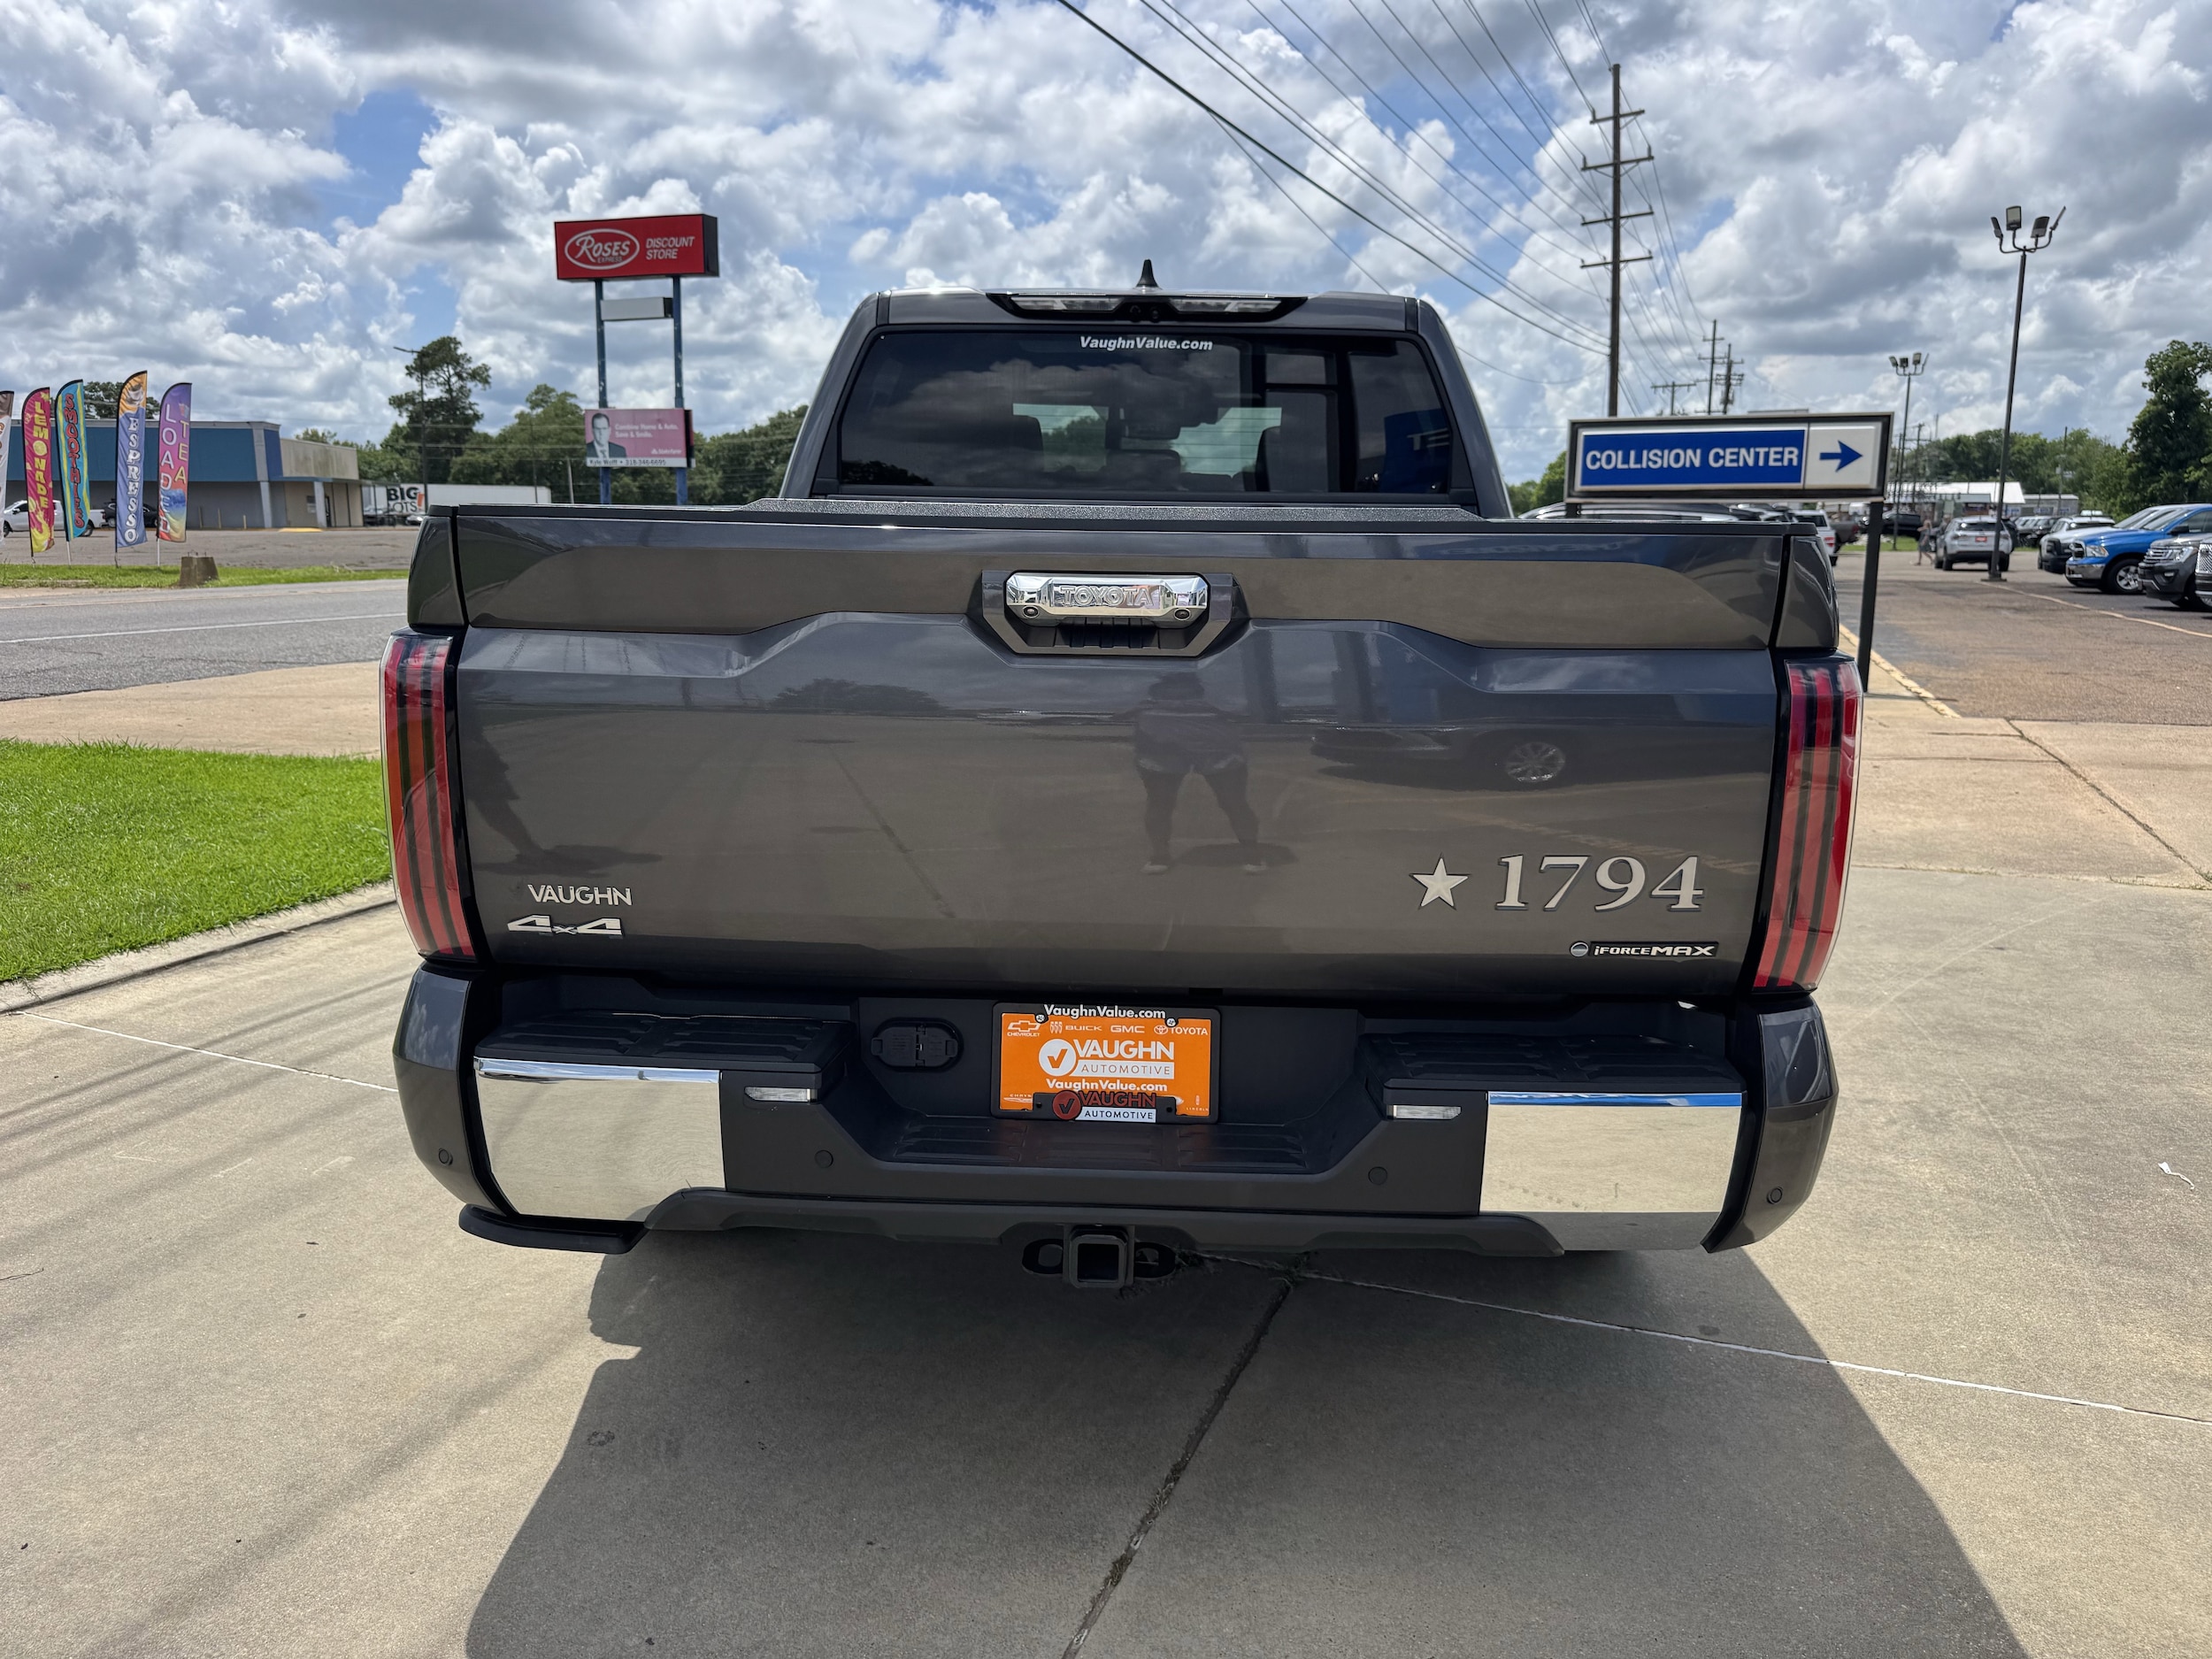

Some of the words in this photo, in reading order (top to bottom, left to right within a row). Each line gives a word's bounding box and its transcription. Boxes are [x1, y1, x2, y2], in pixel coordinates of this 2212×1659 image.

[646, 236, 695, 249] DISCOUNT
[646, 249, 678, 260] STORE
[1079, 336, 1213, 351] VaughnValue.com
[33, 402, 50, 508] LEMONADE
[64, 394, 85, 528] SMOOTHIES
[175, 419, 189, 485] TEA
[1586, 448, 1701, 471] COLLISION
[1708, 446, 1799, 468] CENTER
[159, 404, 177, 534] LOADED
[124, 418, 142, 543] ESPRESSO
[387, 487, 419, 501] BIG
[1060, 585, 1155, 607] TOYOTA
[1495, 854, 1705, 912] 1794
[527, 884, 633, 906] VAUGHN
[1044, 1003, 1166, 1019] VaughnValue.com
[1110, 1025, 1145, 1033] GMC
[1170, 1026, 1209, 1035] TOYOTA
[1072, 1039, 1175, 1060] VAUGHN
[1081, 1064, 1171, 1075] AUTOMOTIVE
[1046, 1078, 1168, 1092] VaughnValue.com
[1078, 1090, 1156, 1108] VAUGHN
[1085, 1110, 1153, 1120] AUTOMOTIVE
